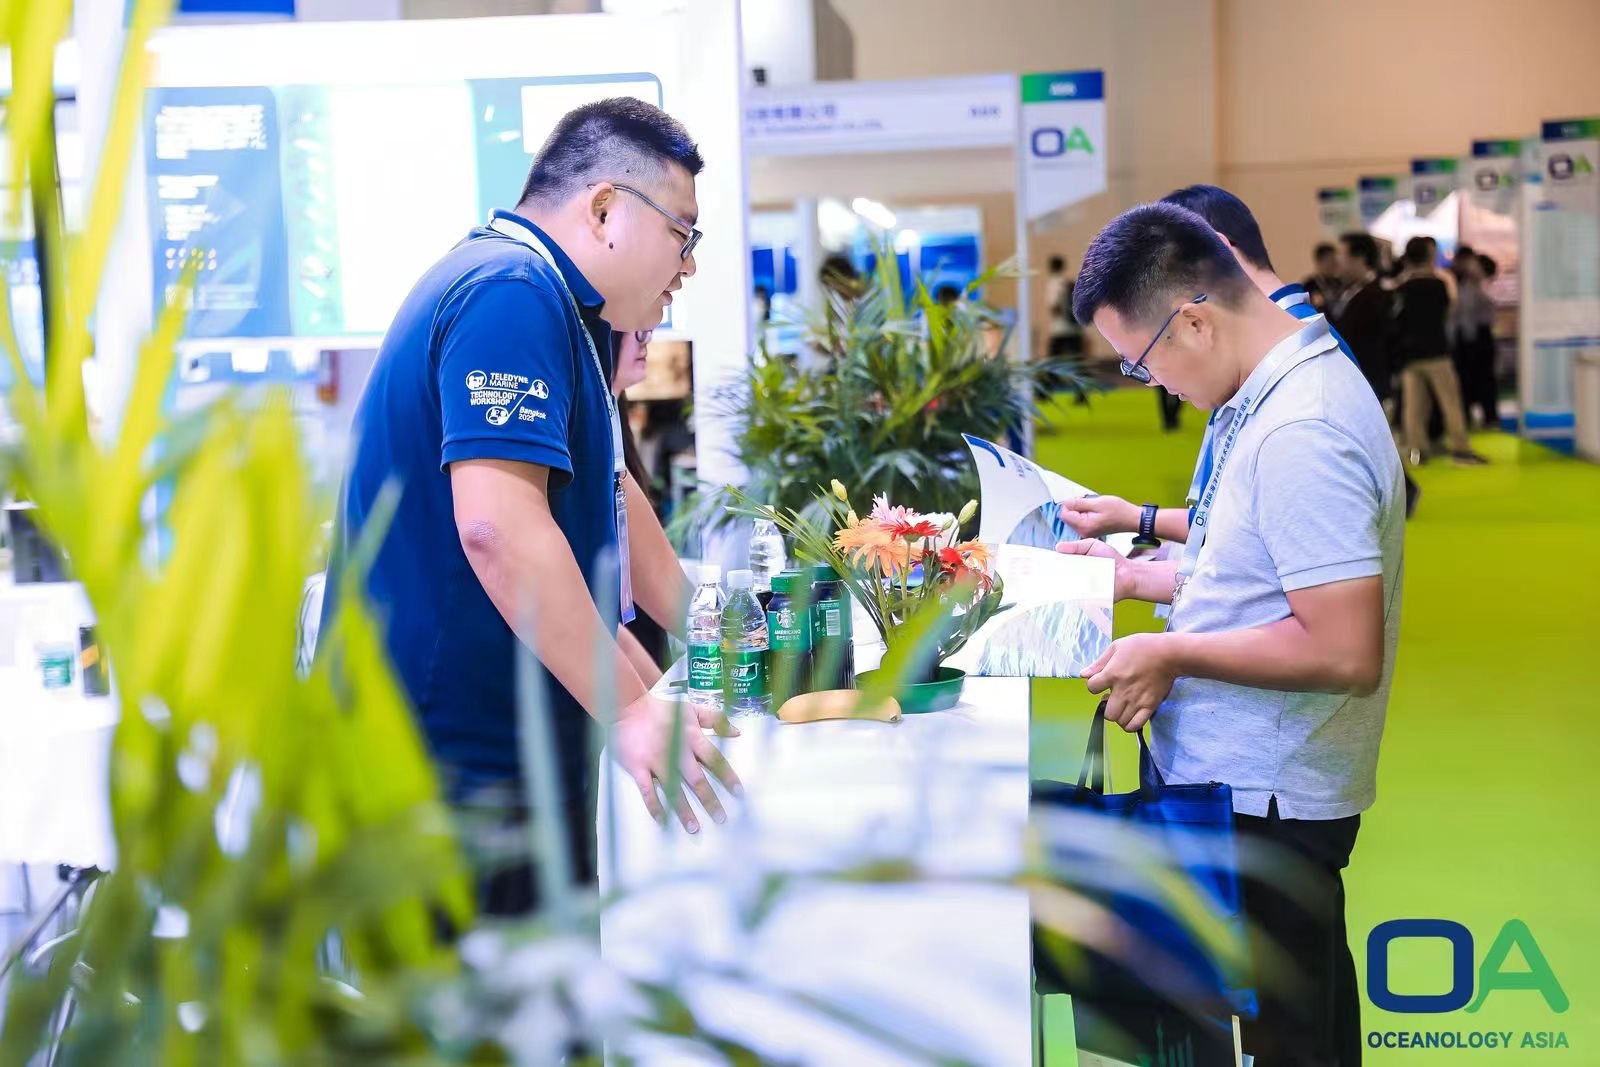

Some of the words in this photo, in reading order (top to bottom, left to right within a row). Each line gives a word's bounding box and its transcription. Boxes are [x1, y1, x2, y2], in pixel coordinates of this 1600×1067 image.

[1031, 125, 1094, 158] OA
[490, 372, 529, 384] TELEDYNE
[489, 380, 519, 389] MARINE
[470, 391, 518, 400] TECHNOLOGY
[470, 398, 511, 406] WORKSHOP
[518, 413, 535, 422] 2023
[519, 406, 547, 420] Bangkok
[1194, 510, 1206, 527] OA
